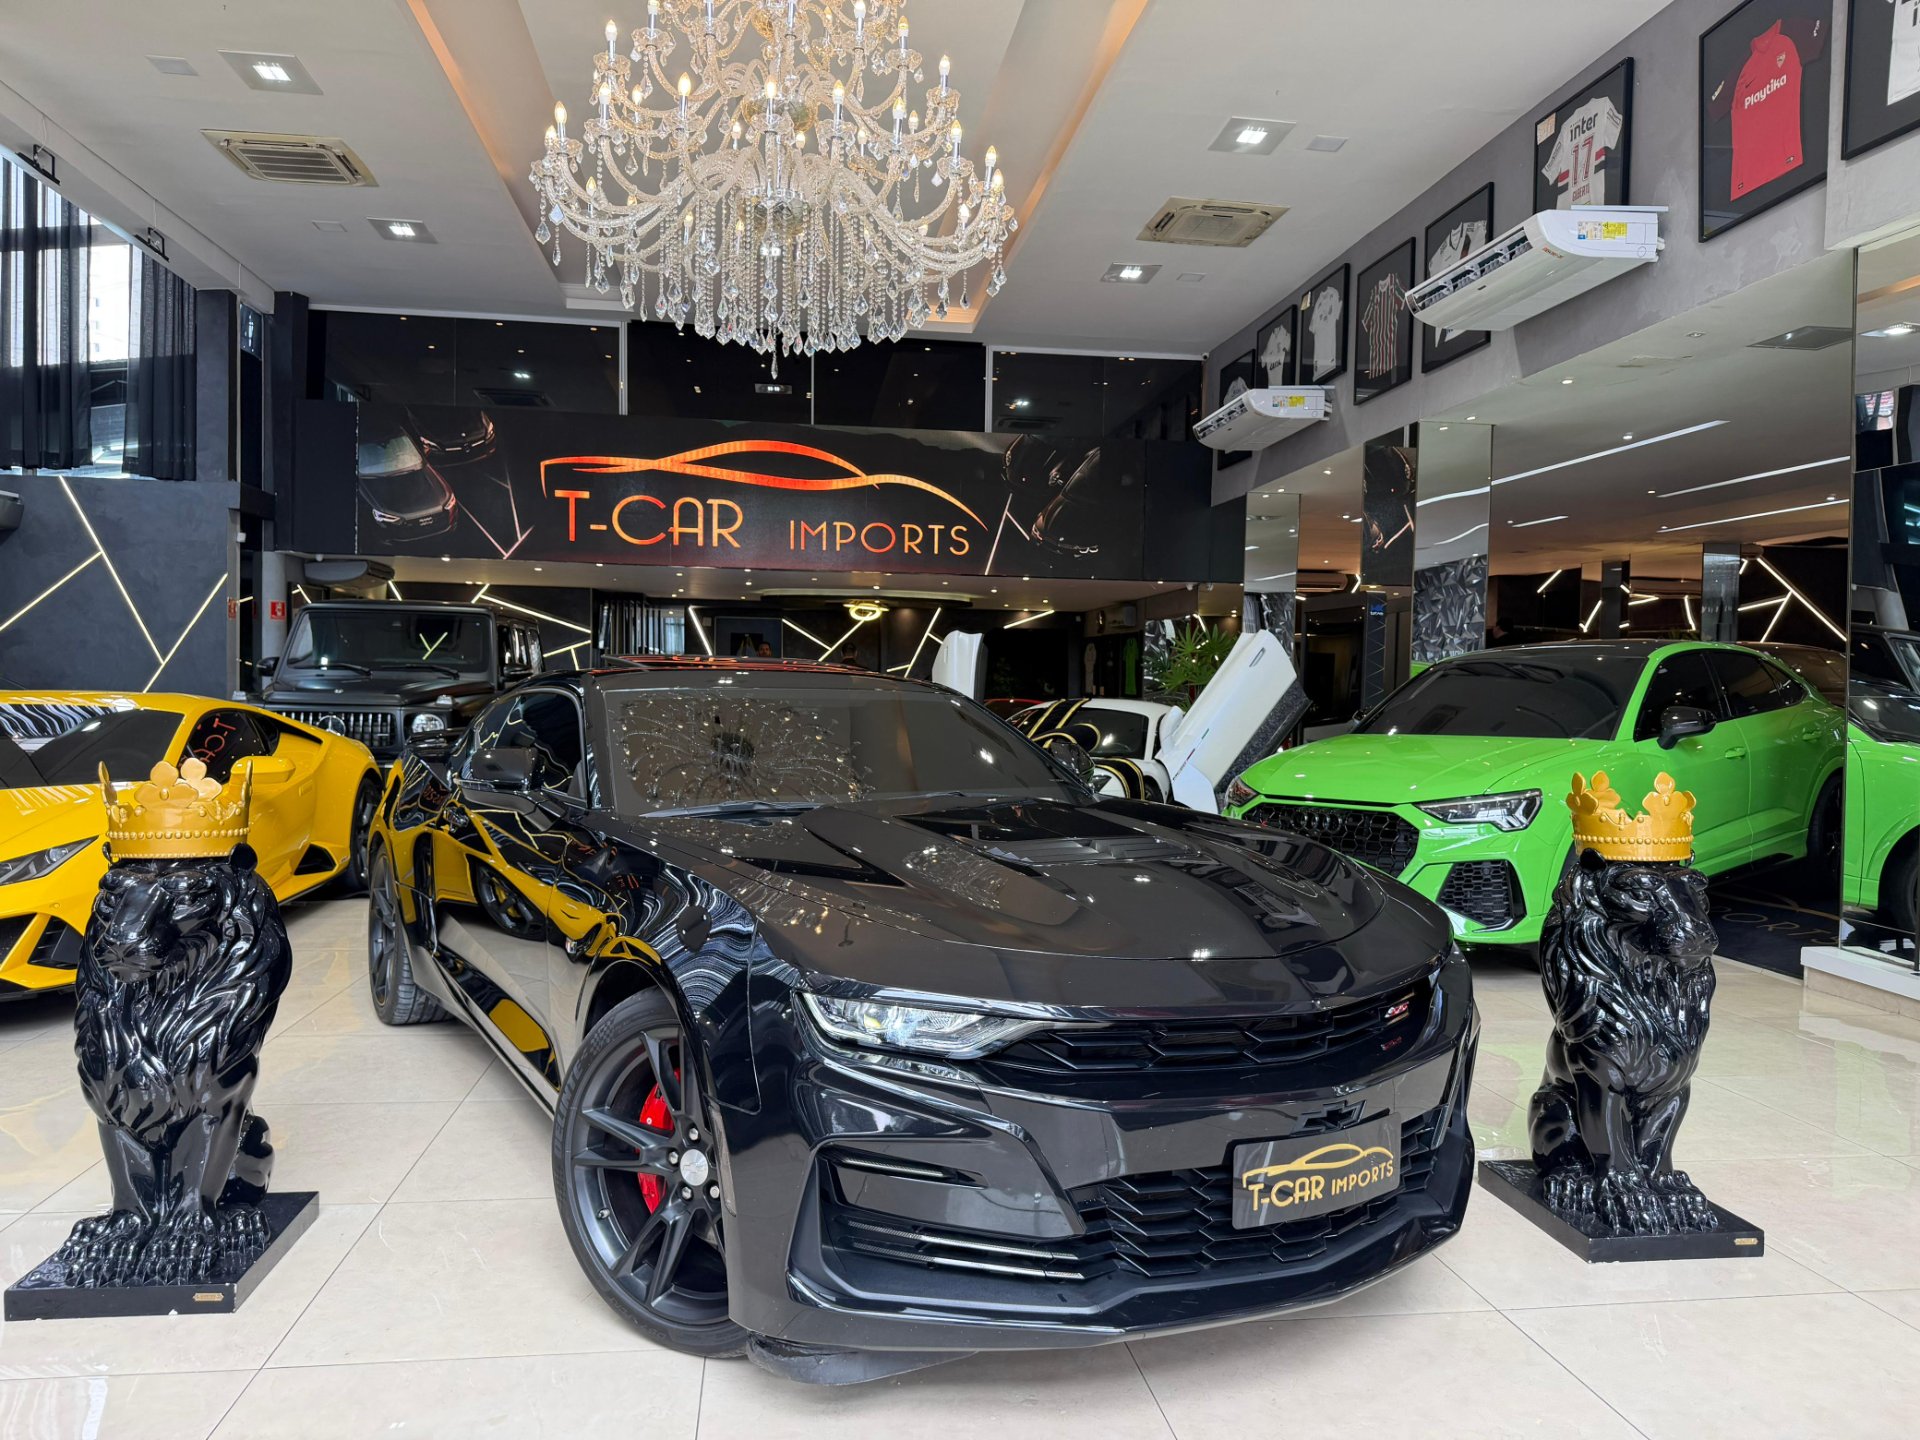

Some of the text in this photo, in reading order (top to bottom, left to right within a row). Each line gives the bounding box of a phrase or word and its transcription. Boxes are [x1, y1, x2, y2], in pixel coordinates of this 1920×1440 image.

[1744, 74, 1787, 109] Playtika
[1570, 113, 1598, 142] inter
[1571, 134, 1595, 187] 17
[554, 489, 971, 556] T-CAR IMPORTS
[1248, 1160, 1394, 1211] T-CAR IMPORTS
